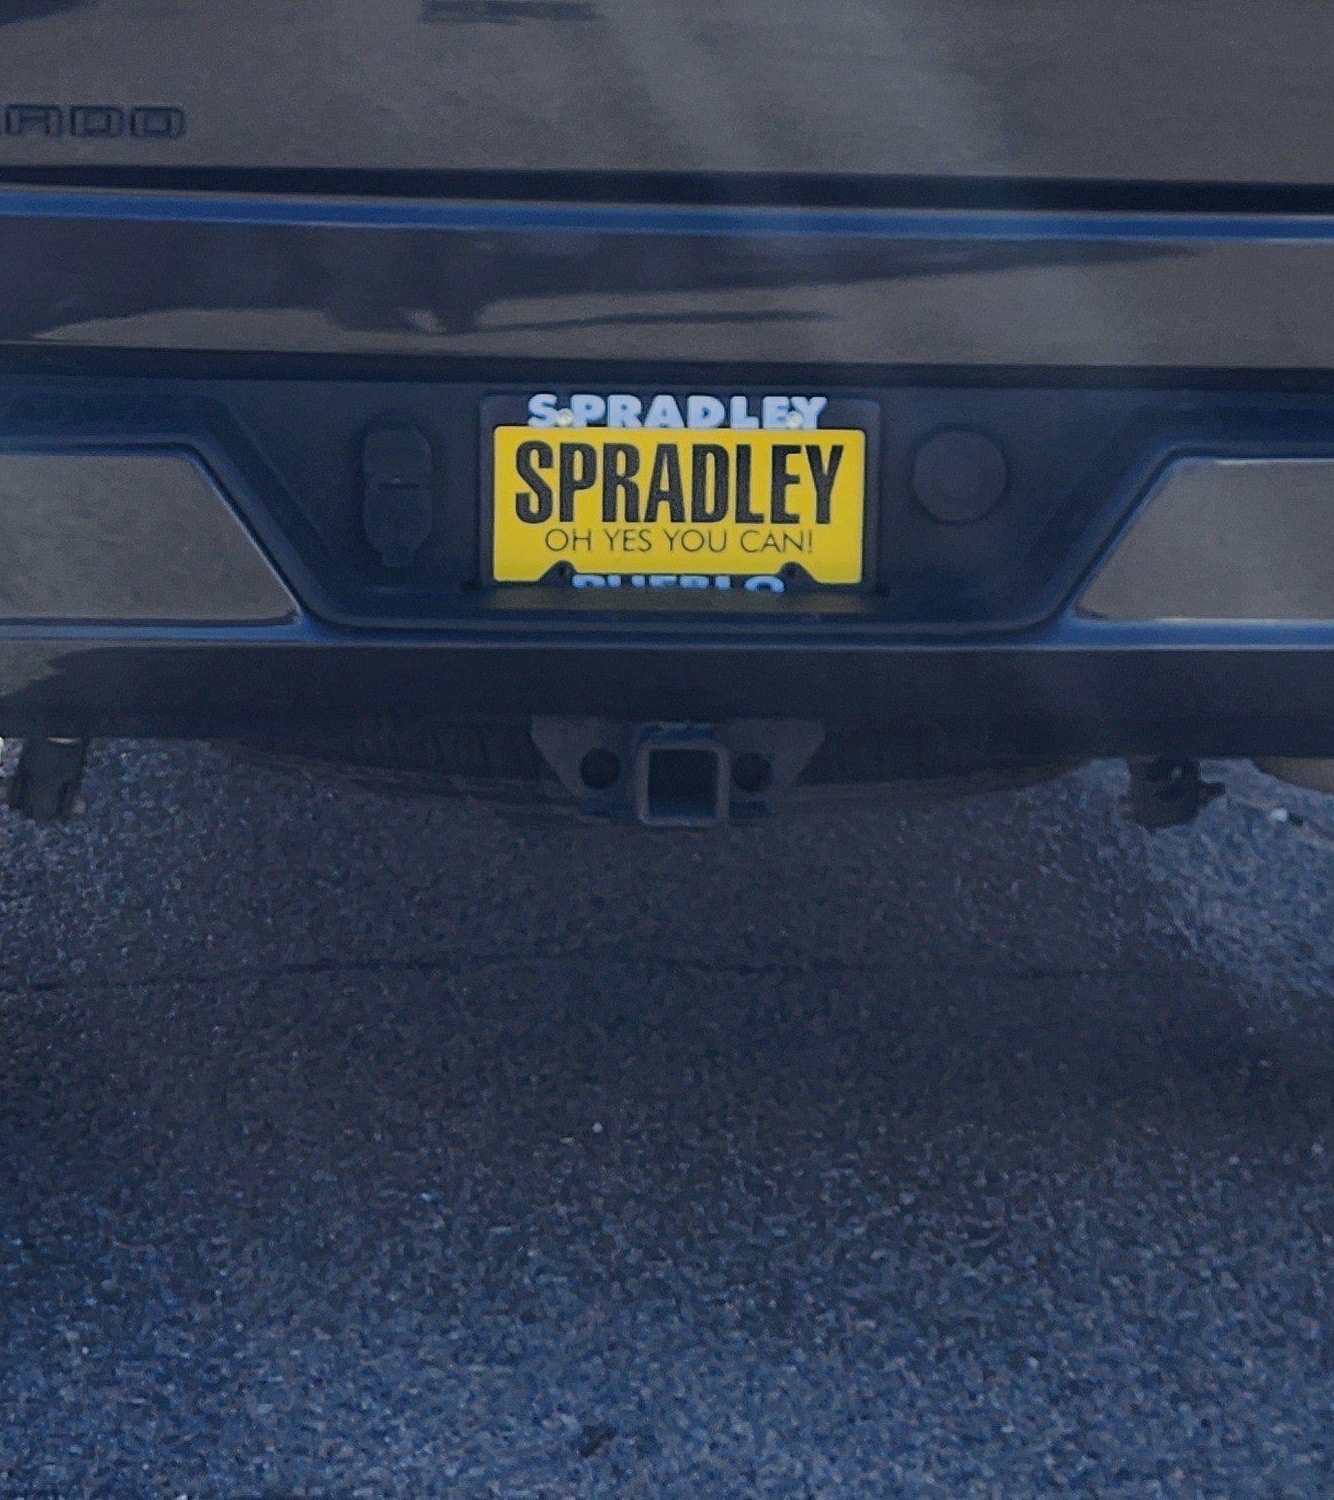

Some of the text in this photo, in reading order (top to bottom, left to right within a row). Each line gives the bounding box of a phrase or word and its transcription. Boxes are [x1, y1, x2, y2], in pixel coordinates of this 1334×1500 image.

[527, 393, 827, 429] SPRADLEY
[514, 440, 845, 526] SPRADLEY
[544, 528, 814, 554] OH YES YOU CAN!
